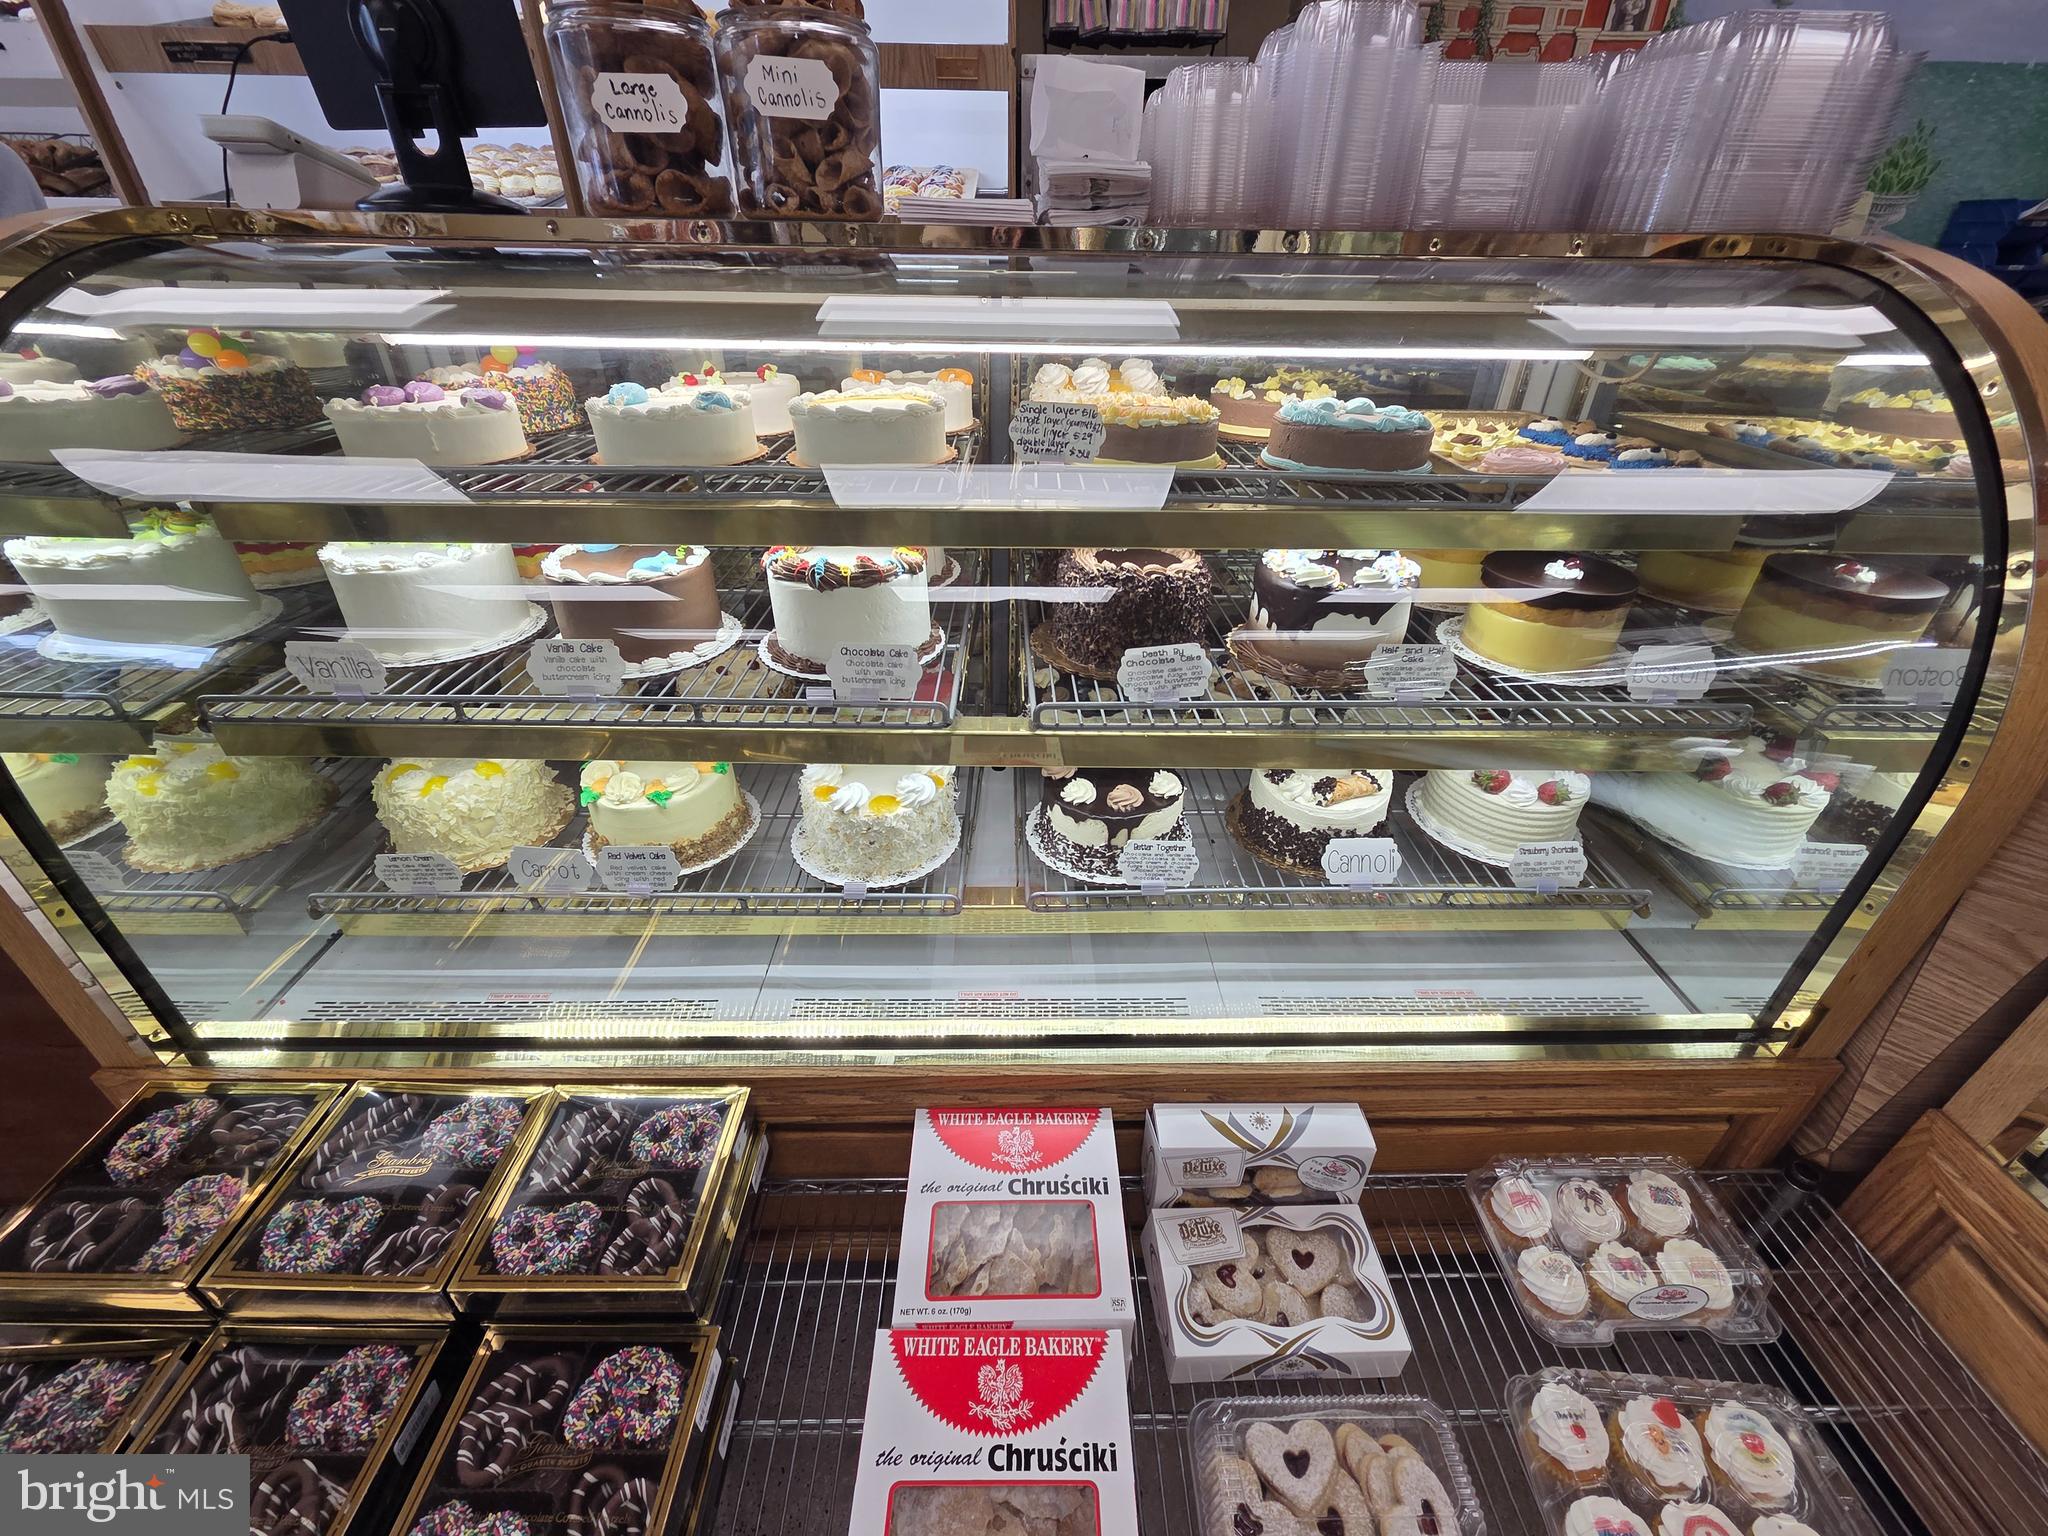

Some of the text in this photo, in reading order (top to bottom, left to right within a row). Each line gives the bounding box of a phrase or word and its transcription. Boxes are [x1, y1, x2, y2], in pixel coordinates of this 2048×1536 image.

[762, 64, 798, 83] Mini
[609, 78, 658, 104] Large
[757, 87, 827, 109] Cannolis
[604, 102, 678, 125] Cannolis
[1019, 404, 1048, 415] Single
[1053, 404, 1081, 419] layer
[1016, 438, 1046, 446] double
[546, 643, 604, 654] Vanilla Cake
[840, 647, 909, 658] Chocolate Cake
[1142, 648, 1185, 659] Death By
[1381, 646, 1400, 654] Half
[1429, 647, 1447, 655] Half
[1126, 655, 1202, 668] Chocolate Cake
[1401, 655, 1424, 663] Cake
[296, 656, 374, 679] Vanilla
[1632, 662, 1709, 684] Boston
[1133, 843, 1187, 854] Better Together
[1519, 846, 1579, 856] Strawberry Shortcake
[624, 852, 646, 860] Velvet
[649, 852, 666, 860] Cake
[1328, 849, 1396, 874] Cannoli
[938, 1113, 1091, 1126] WHITE EAGLE BAKERY
[920, 1174, 1110, 1197] the original Chruściki
[917, 1308, 930, 1316] WT.
[950, 1306, 972, 1316] (170g)
[903, 1337, 1094, 1357] WHITE EAGLE BAKERY
[875, 1436, 1118, 1473] the original Chruściki
